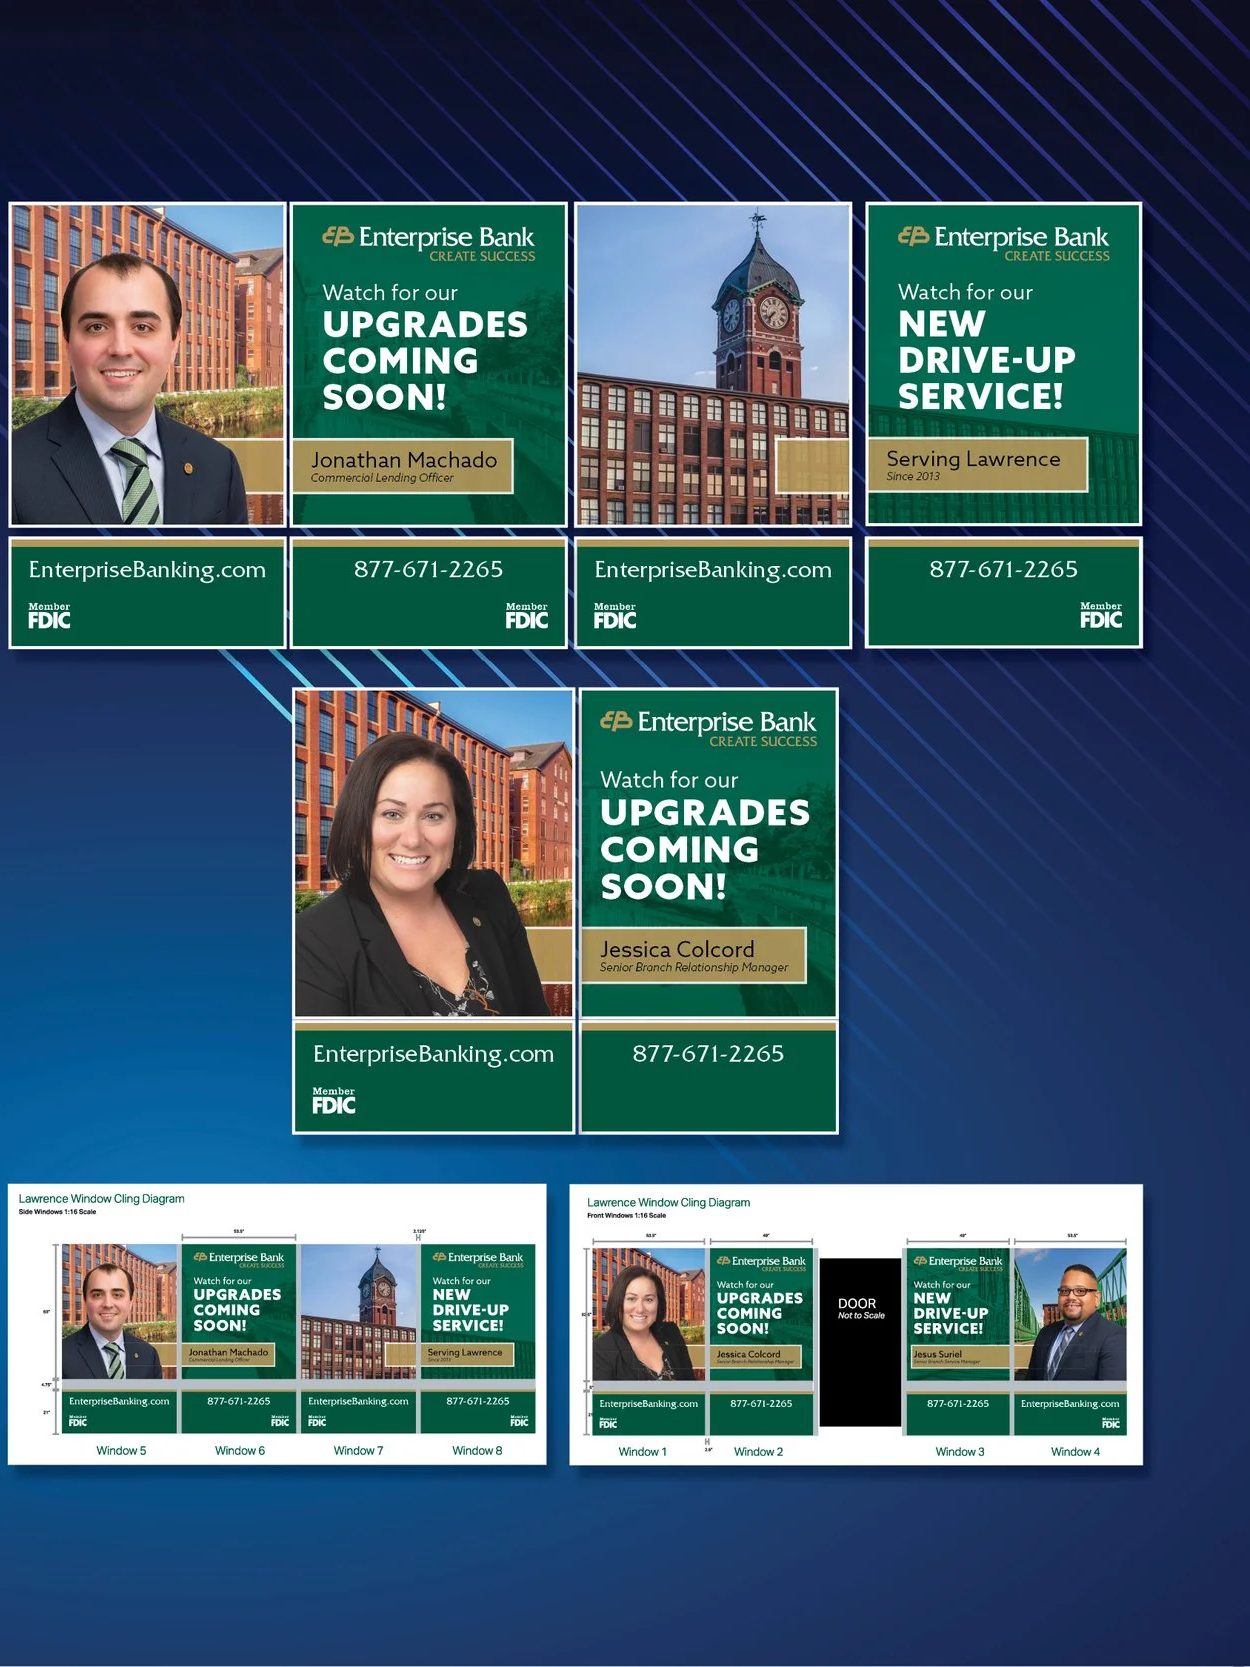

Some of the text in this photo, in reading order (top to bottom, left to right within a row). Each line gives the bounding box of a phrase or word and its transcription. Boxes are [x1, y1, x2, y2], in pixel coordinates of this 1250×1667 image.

[359, 226, 535, 250] Enterprise Bank
[935, 226, 1110, 251] Enterprise Bank
[429, 250, 536, 262] CREATE SUCCESS
[1004, 250, 1111, 262] CREATE SUCCESS
[322, 283, 459, 301] Watch for our
[897, 282, 1034, 301] Watch for our
[323, 310, 528, 338] UPGRADES
[899, 309, 987, 338] NEW
[323, 346, 478, 375] COMING
[899, 346, 1076, 374] DRIVE-UP
[323, 383, 446, 411] SOON!
[898, 382, 1063, 410] SERVICE!
[311, 450, 498, 469] Jonathan Machado
[887, 449, 1061, 472] Serving Lawrence
[310, 471, 455, 485] Commercial Lending Officer
[886, 471, 941, 481] Since 2013
[29, 560, 266, 584] EnterpriseBanking.com
[354, 560, 503, 578] 877-671-2265
[595, 560, 832, 584] EnterpriseBanking.com
[930, 560, 1078, 578] 877-671-2265
[28, 602, 71, 611] Member
[505, 602, 548, 611] Member
[593, 602, 636, 611] Member
[1080, 601, 1123, 611] Member
[28, 611, 71, 629] FDIC
[505, 611, 549, 629] FDIC
[593, 611, 637, 629] FDIC
[1080, 610, 1123, 629] FDIC
[638, 711, 817, 736] Enterprise Bank
[709, 735, 818, 747] CREATE SUCCESS
[600, 769, 739, 789] Watch for our
[601, 798, 810, 827] UPGRADES
[600, 835, 759, 864] COMING
[601, 872, 726, 901] SOON!
[600, 939, 755, 958] Jessica Colcord
[599, 961, 790, 975] Senior Branch Relationship Manager
[314, 1044, 554, 1069] EnterpriseBanking.com
[633, 1044, 784, 1063] 877-671-2265
[312, 1086, 356, 1096] Member
[312, 1096, 356, 1115] FDIC
[18, 1193, 185, 1206] Lawrence Window Cling Diagram
[587, 1197, 751, 1210] Lawrence Window Cling Diagram
[193, 1288, 282, 1301] UPGRADES
[433, 1288, 471, 1301] NEW
[193, 1303, 260, 1317] COMING
[432, 1303, 510, 1317] DRIVE-UP
[838, 1297, 877, 1310] DOOR
[837, 1311, 886, 1320] Not to Scale
[193, 1319, 247, 1332] SOON!
[432, 1319, 504, 1332] SERVICE!
[189, 1348, 228, 1360] Jonathan
[229, 1347, 269, 1360] Machado
[427, 1348, 503, 1359] Serving Lawrence
[207, 1396, 271, 1406] 877-671-2265
[96, 1445, 147, 1456] Window 5
[214, 1445, 266, 1456] Window 6
[333, 1445, 384, 1456] Window 7
[452, 1445, 503, 1456] Window 8
[618, 1446, 667, 1457] Window 1
[733, 1446, 784, 1457] Window 2
[935, 1446, 985, 1457] Window 3
[1050, 1446, 1101, 1457] Window 4
